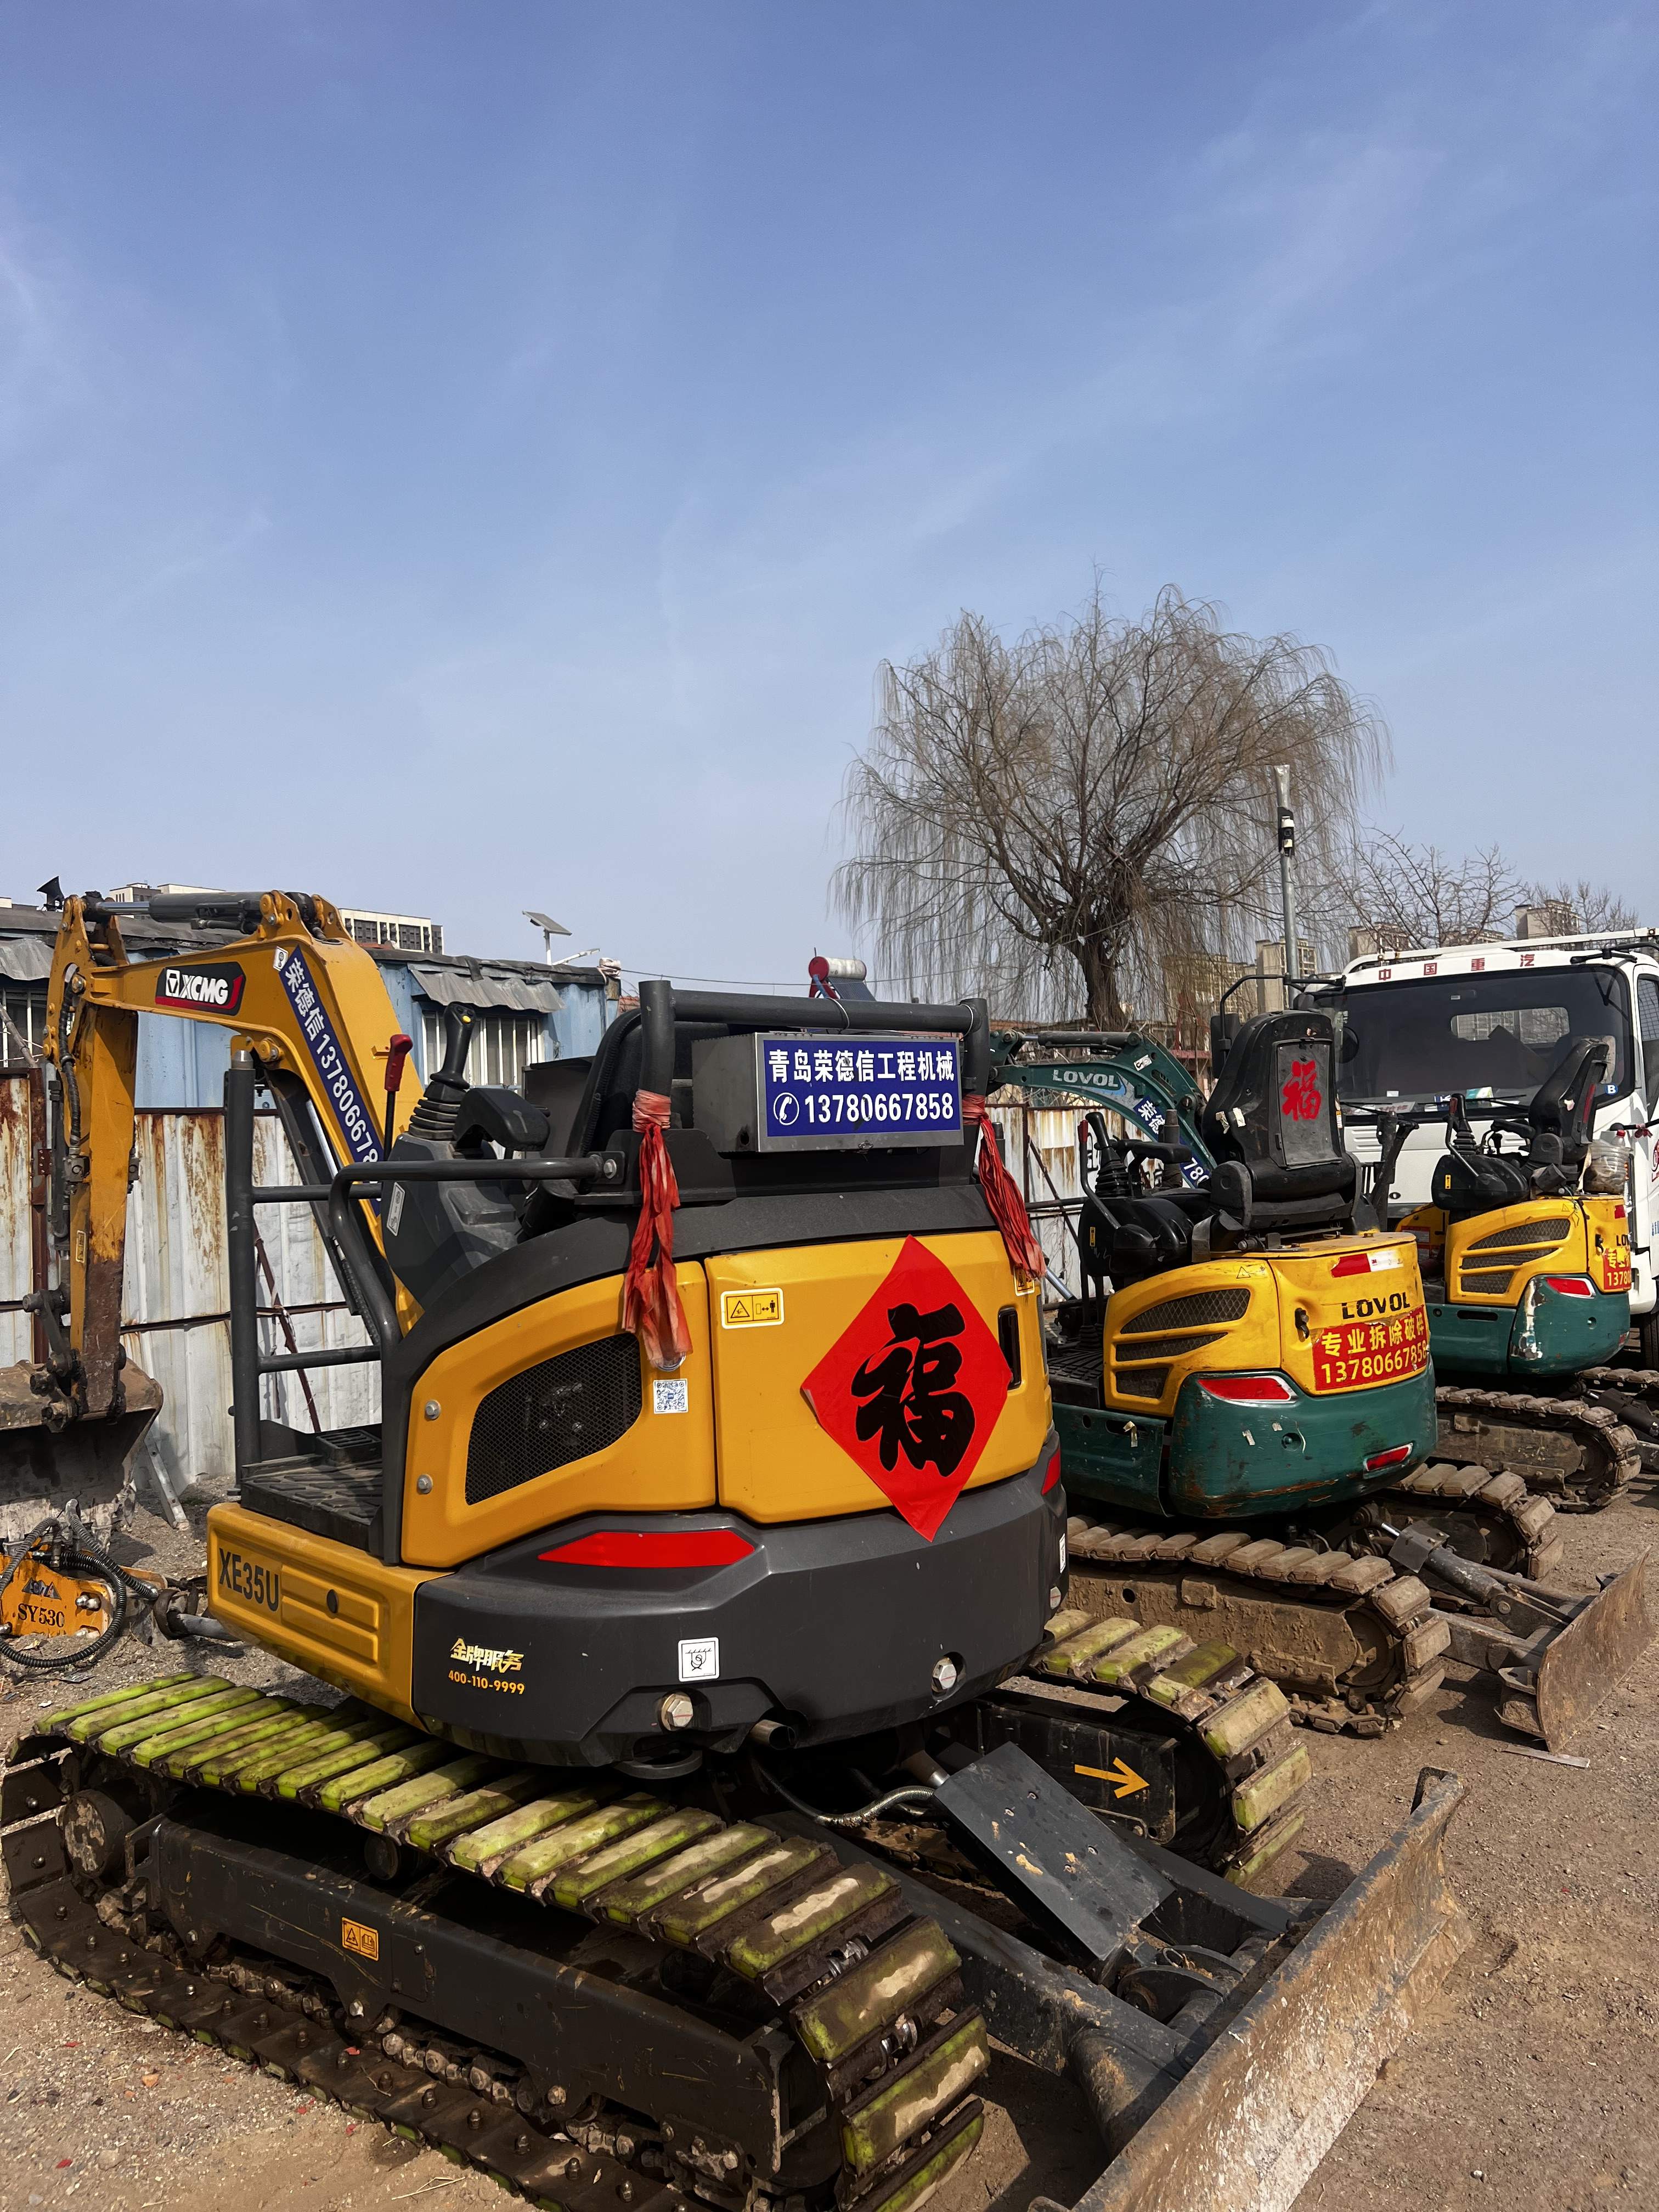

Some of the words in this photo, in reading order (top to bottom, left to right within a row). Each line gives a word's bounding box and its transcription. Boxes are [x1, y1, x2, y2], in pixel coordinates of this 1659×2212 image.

[1379, 953, 1536, 981] 中国重汽
[179, 974, 229, 1005] XCMG
[769, 1049, 955, 1083] 青岛荣德信工程机械
[1052, 1069, 1119, 1088] LOVOL
[1282, 1059, 1322, 1121] 福
[1607, 1085, 1616, 1094] B
[805, 1092, 954, 1123] 13780667858
[1341, 1291, 1410, 1320] LOVOL
[1321, 1312, 1425, 1357] 专业拆除破碎
[1321, 1340, 1427, 1384] 13780667858
[850, 1302, 977, 1477] 福
[219, 1547, 279, 1612] XE35U
[18, 1603, 65, 1628] SY530
[450, 1638, 524, 1673] 金牌服务
[448, 1669, 525, 1695] 400-110-9999
